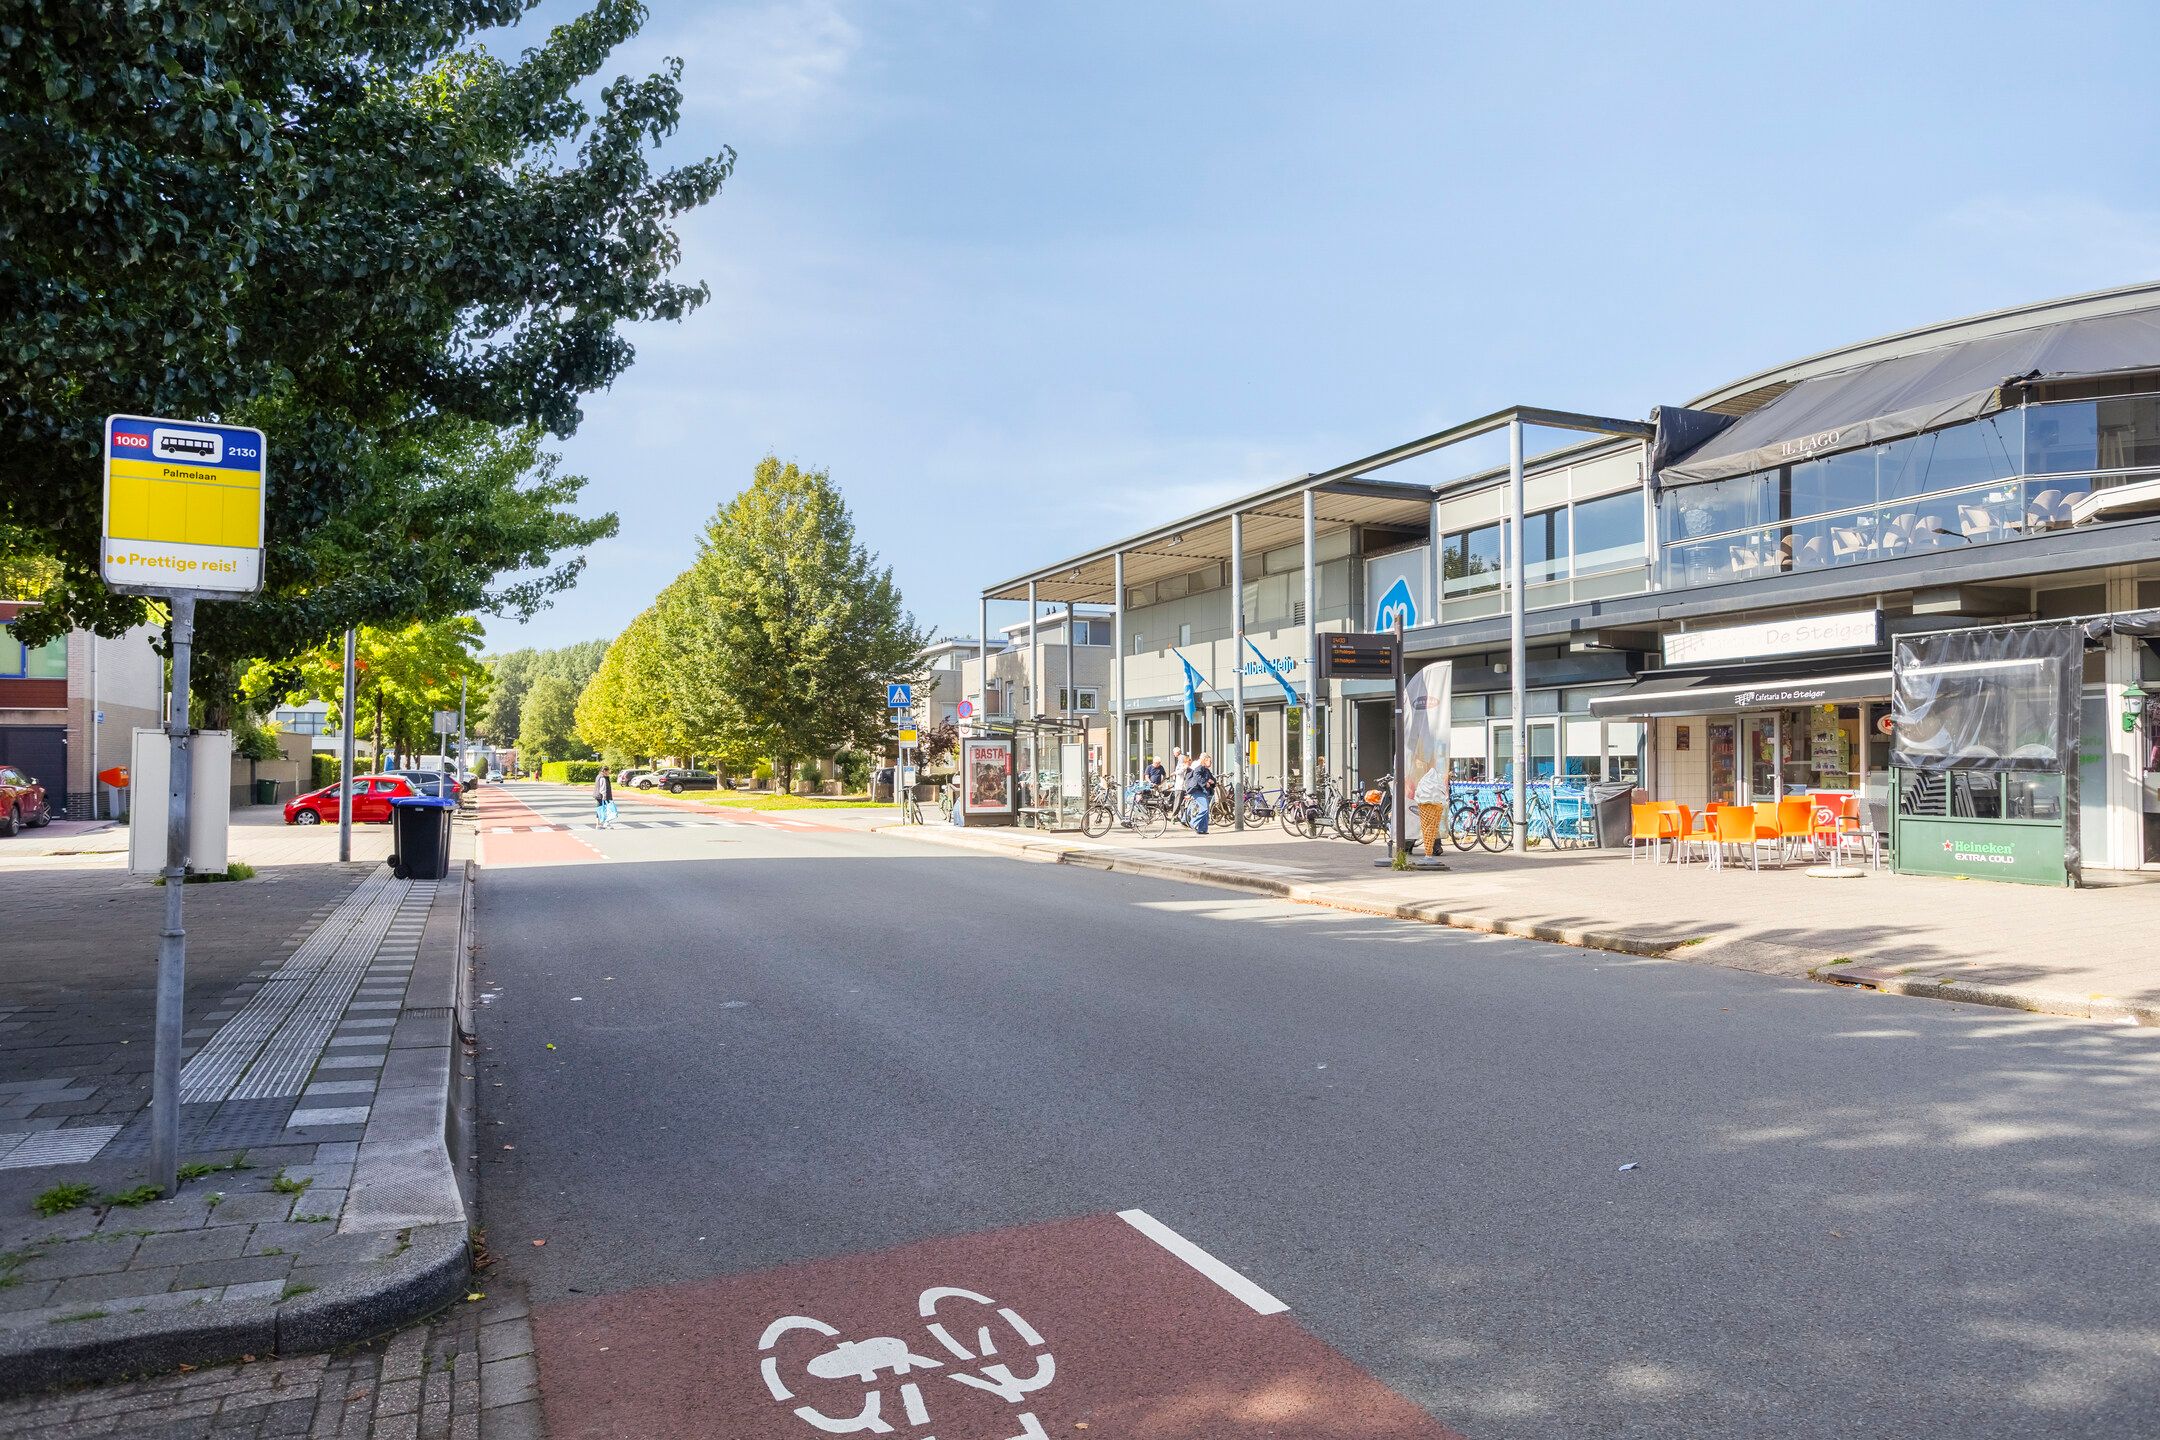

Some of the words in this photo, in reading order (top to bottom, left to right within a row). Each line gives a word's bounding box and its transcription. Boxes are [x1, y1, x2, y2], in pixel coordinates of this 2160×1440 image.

[115, 435, 148, 448] 1000
[1782, 442, 1796, 457] IL
[1799, 431, 1839, 451] LAGO
[228, 447, 257, 458] 2130
[163, 468, 217, 482] Palmelaan
[129, 553, 197, 571] Prettige
[201, 559, 237, 573] reis!
[1766, 629, 1791, 645] De
[1796, 623, 1875, 642] Steiger
[1781, 691, 1792, 700] De
[1793, 690, 1825, 699] Steiger
[975, 748, 1003, 759] BASTA
[1955, 841, 2012, 854] Heineken
[1955, 853, 1987, 861] EXTRA
[1988, 855, 2014, 863] COLD
